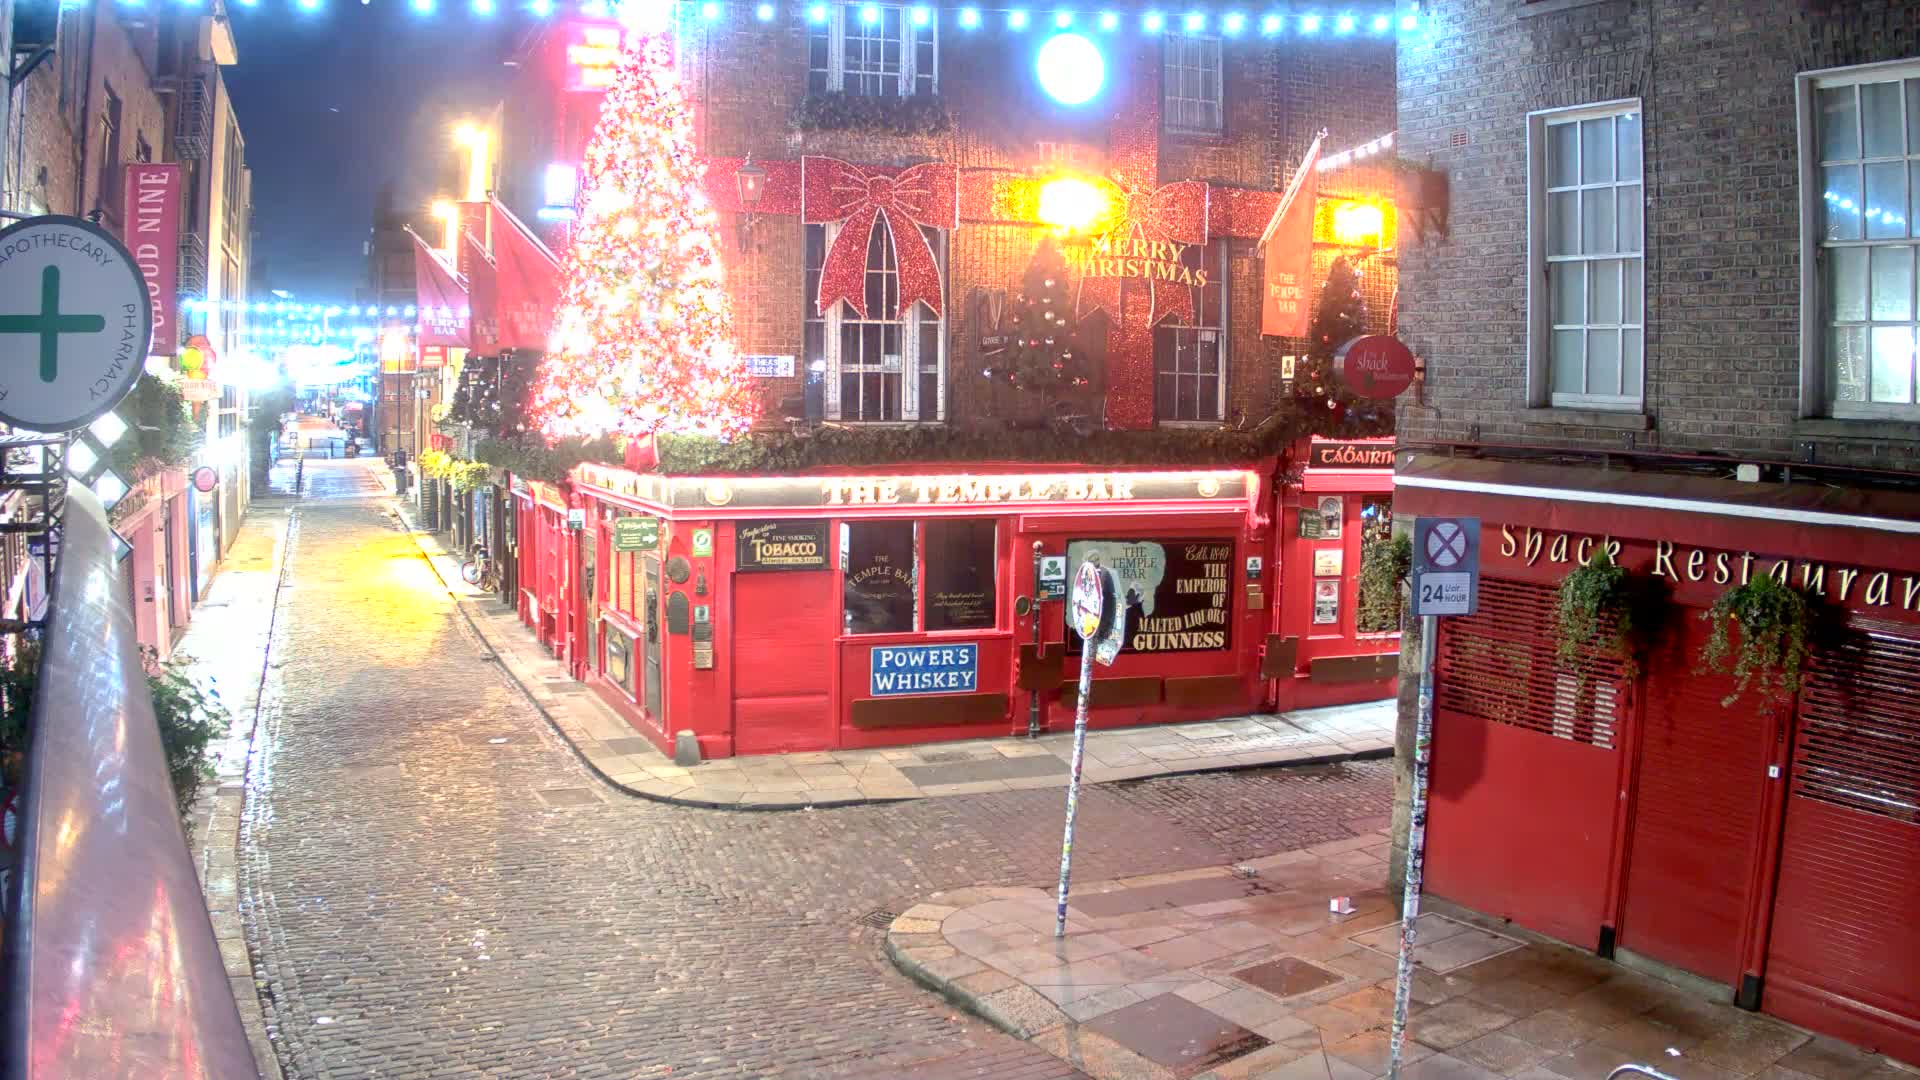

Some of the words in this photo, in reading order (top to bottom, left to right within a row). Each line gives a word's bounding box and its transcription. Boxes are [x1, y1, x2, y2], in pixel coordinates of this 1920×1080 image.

[137, 171, 169, 233] NINE
[1090, 237, 1186, 263] MERRY
[88, 303, 136, 401] PHARMACY
[822, 479, 899, 504] THE
[912, 477, 1058, 504] TEMPLE
[1064, 476, 1135, 500] BAR
[750, 539, 817, 562] TOBACCO
[1122, 546, 1148, 558] THE
[1209, 545, 1230, 559] 1840
[1500, 522, 1621, 567] Shack
[1110, 557, 1158, 568] TEMPLE
[1203, 563, 1227, 578] THE
[847, 565, 892, 587] TEMPLE
[894, 567, 913, 588] BAR
[1121, 568, 1146, 579] BAR
[1176, 578, 1227, 594] EMPEROR
[1422, 584, 1444, 603] 24
[1212, 593, 1226, 608] OF
[1444, 592, 1467, 602] HOUR
[1138, 614, 1182, 633] MALTED
[1183, 608, 1227, 629] LIQUORS
[1133, 631, 1225, 651] GUINNESS
[880, 648, 970, 668] POWER'S
[874, 671, 974, 691] WHISKEY
